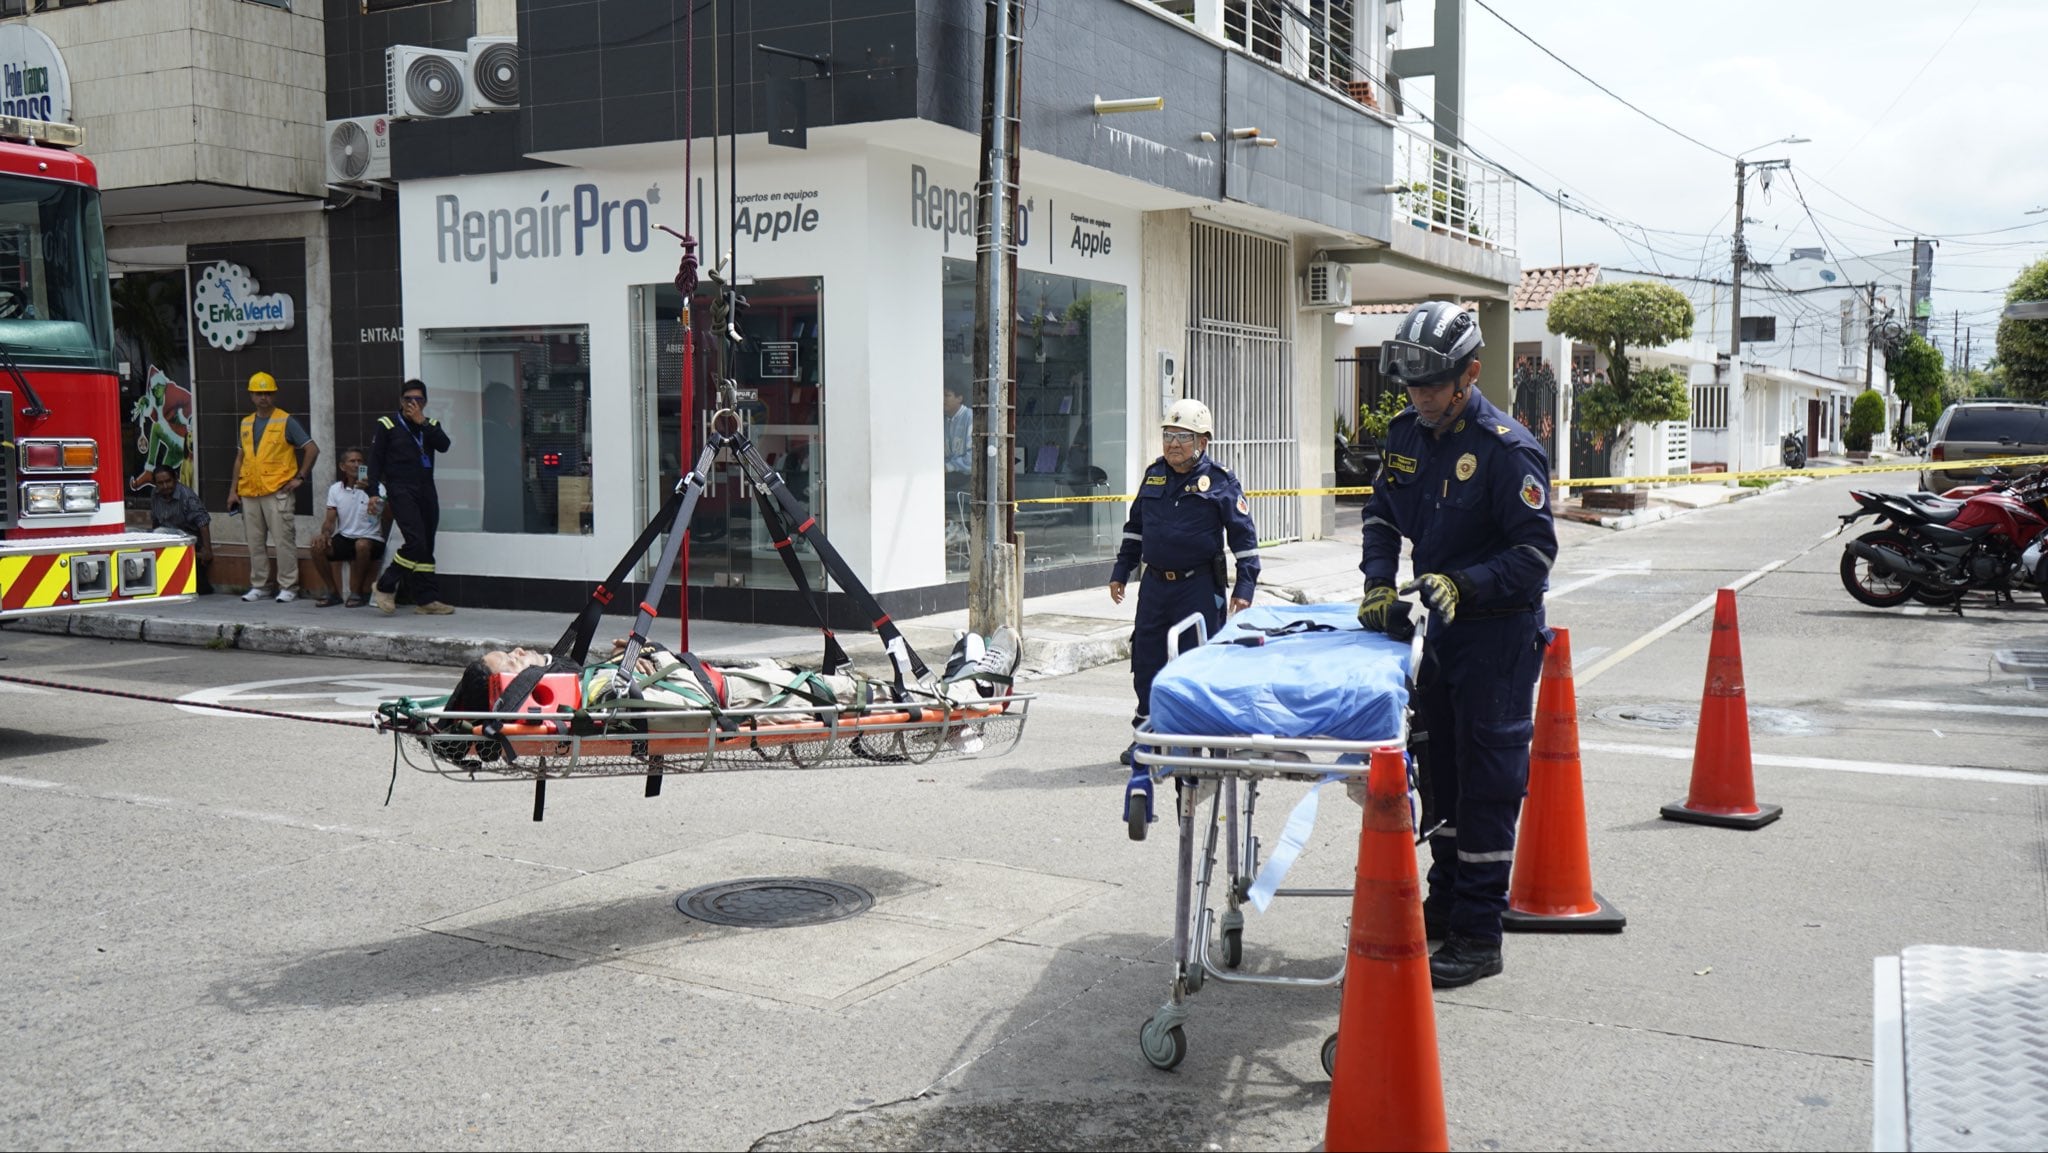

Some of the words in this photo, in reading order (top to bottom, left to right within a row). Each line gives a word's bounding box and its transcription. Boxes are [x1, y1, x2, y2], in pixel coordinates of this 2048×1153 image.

[375, 139, 386, 148] LG
[735, 193, 769, 205] xpertos
[770, 193, 782, 201] en
[783, 189, 819, 201] equipos
[735, 203, 819, 242] Apple
[1071, 224, 1111, 258] Apple
[360, 326, 404, 343] ENTRAD
